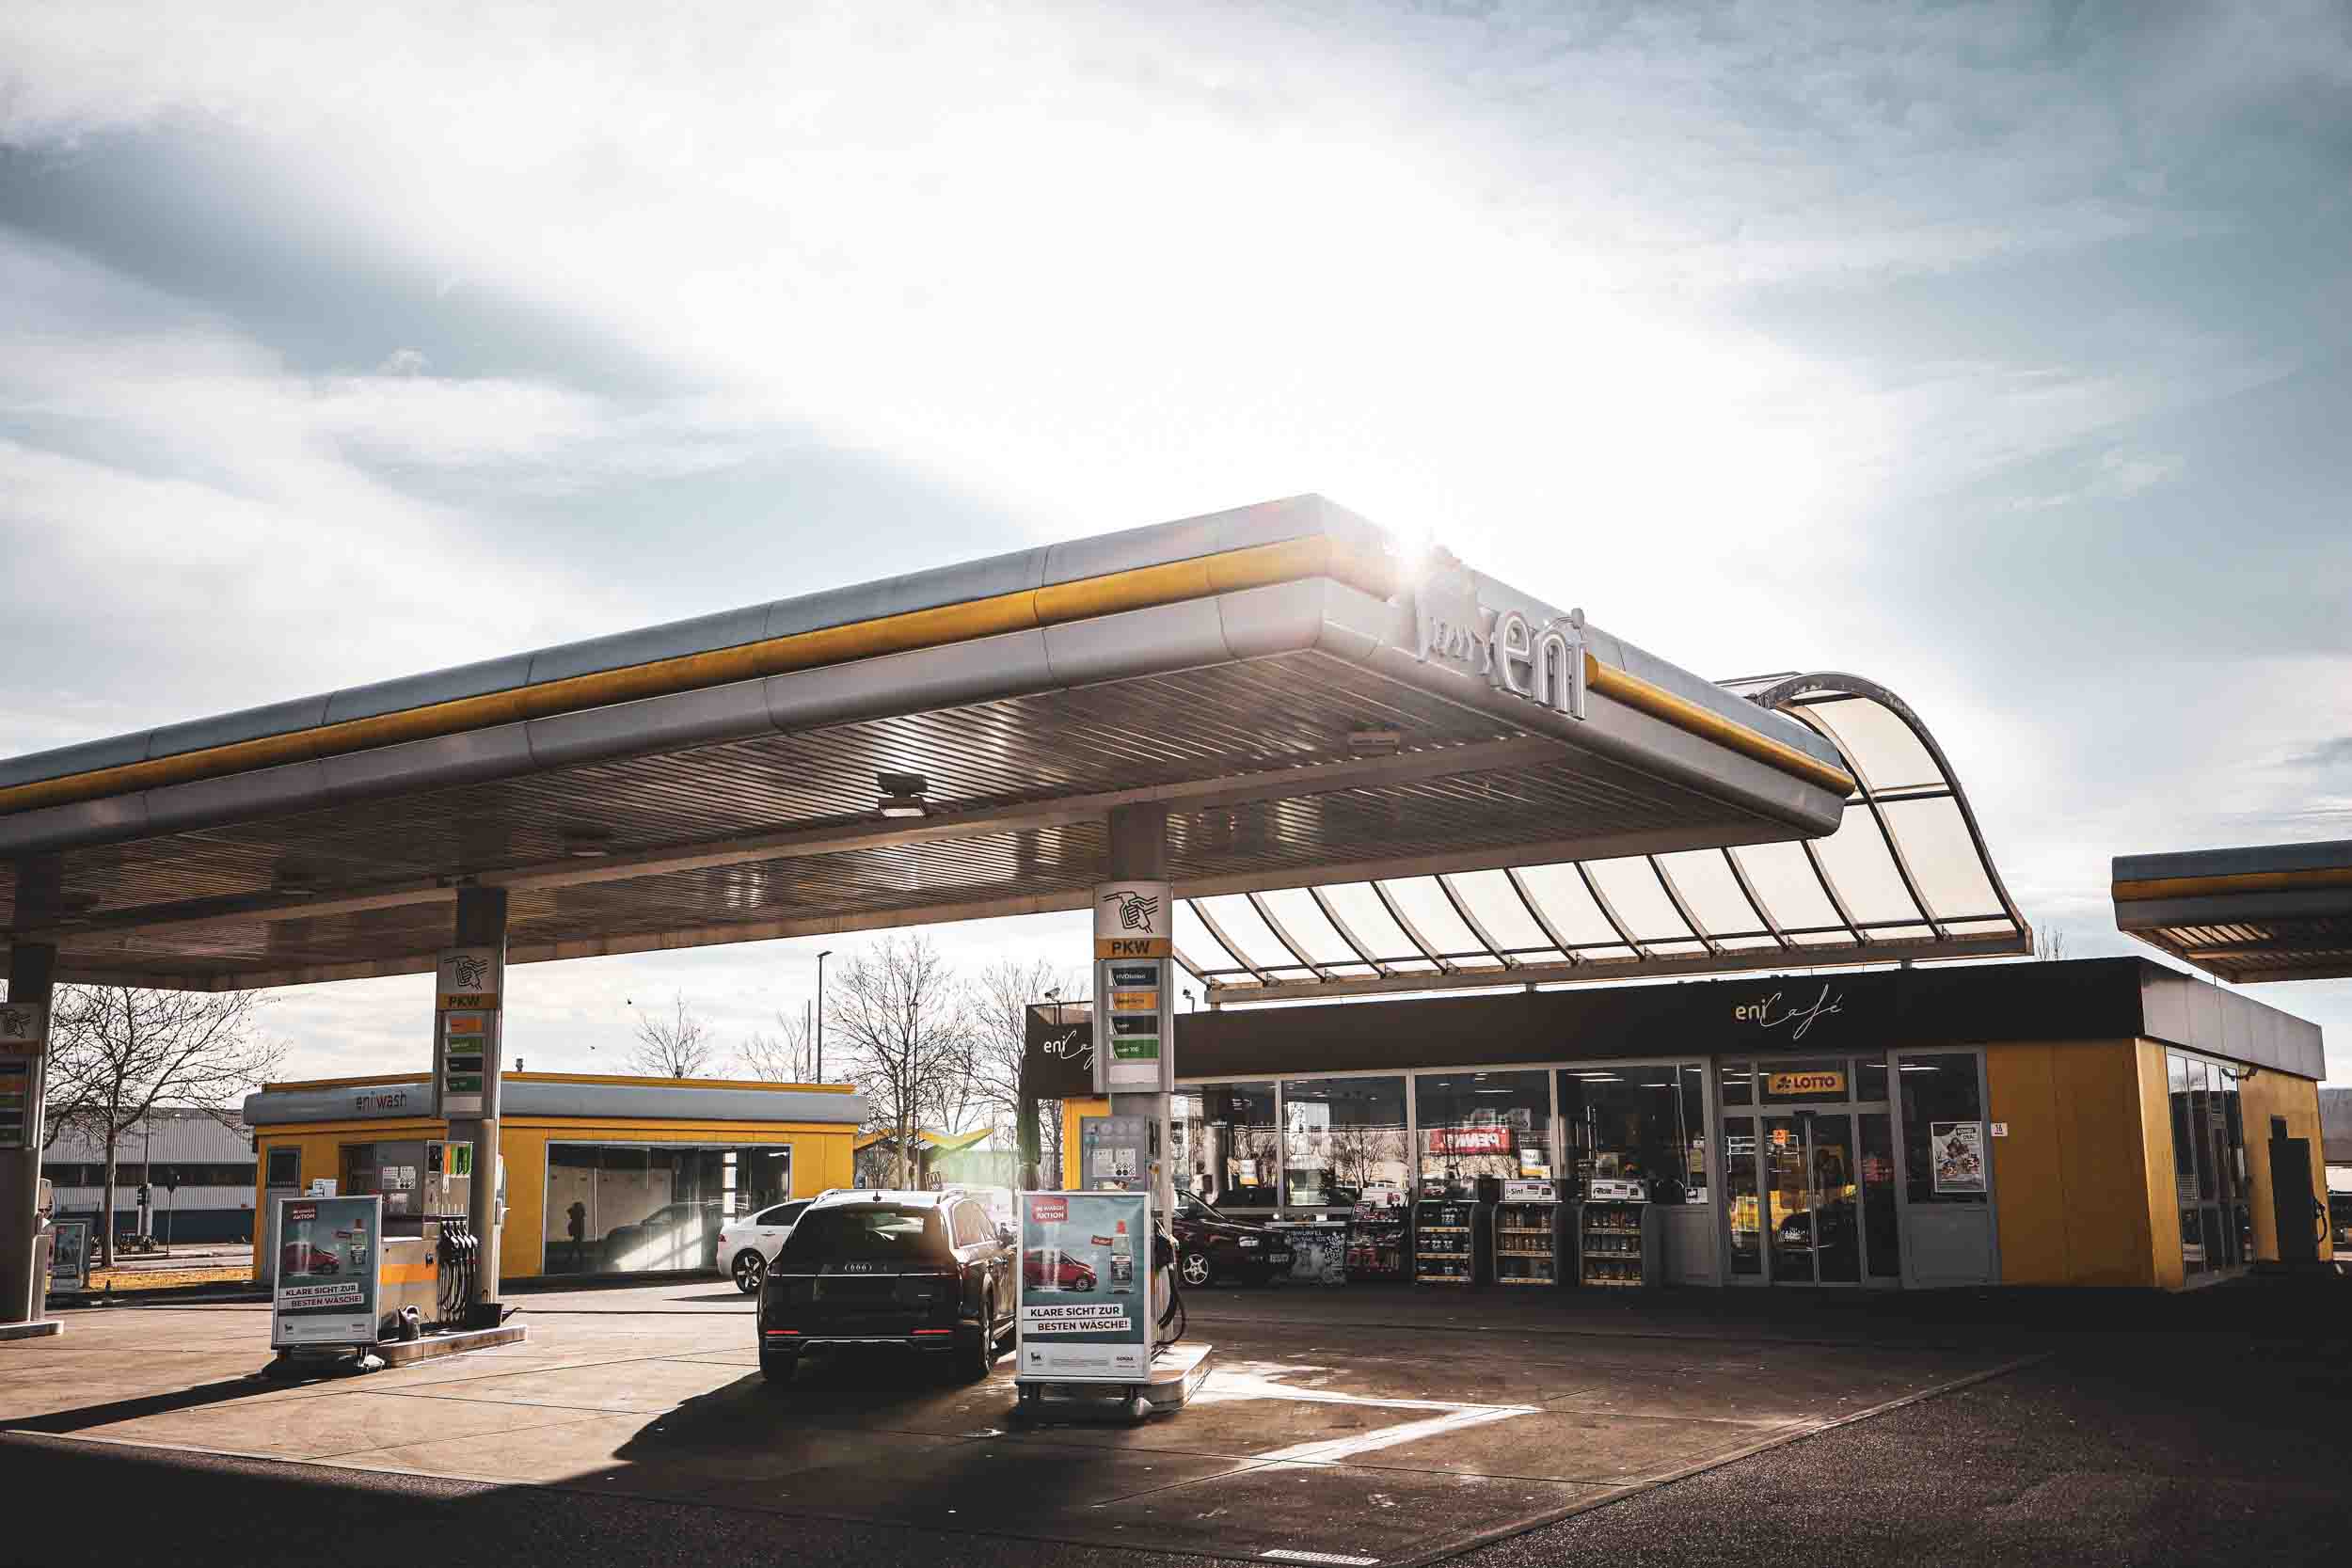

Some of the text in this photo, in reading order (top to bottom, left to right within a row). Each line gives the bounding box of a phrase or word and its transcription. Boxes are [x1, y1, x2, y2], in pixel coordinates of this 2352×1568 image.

[1497, 609, 1586, 721] eni
[1111, 941, 1151, 955] PKW
[449, 996, 480, 1007] PKW
[1793, 1075, 1836, 1088] LOTTO
[1037, 1212, 1064, 1220] AKTION
[286, 1288, 312, 1296] KLARE
[314, 1286, 338, 1294] SICHT
[292, 1298, 323, 1307] BESTEN
[1030, 1307, 1120, 1317] KLARE SICHT ZUR
[1038, 1319, 1128, 1331] BESTEN WÄSCHE!
